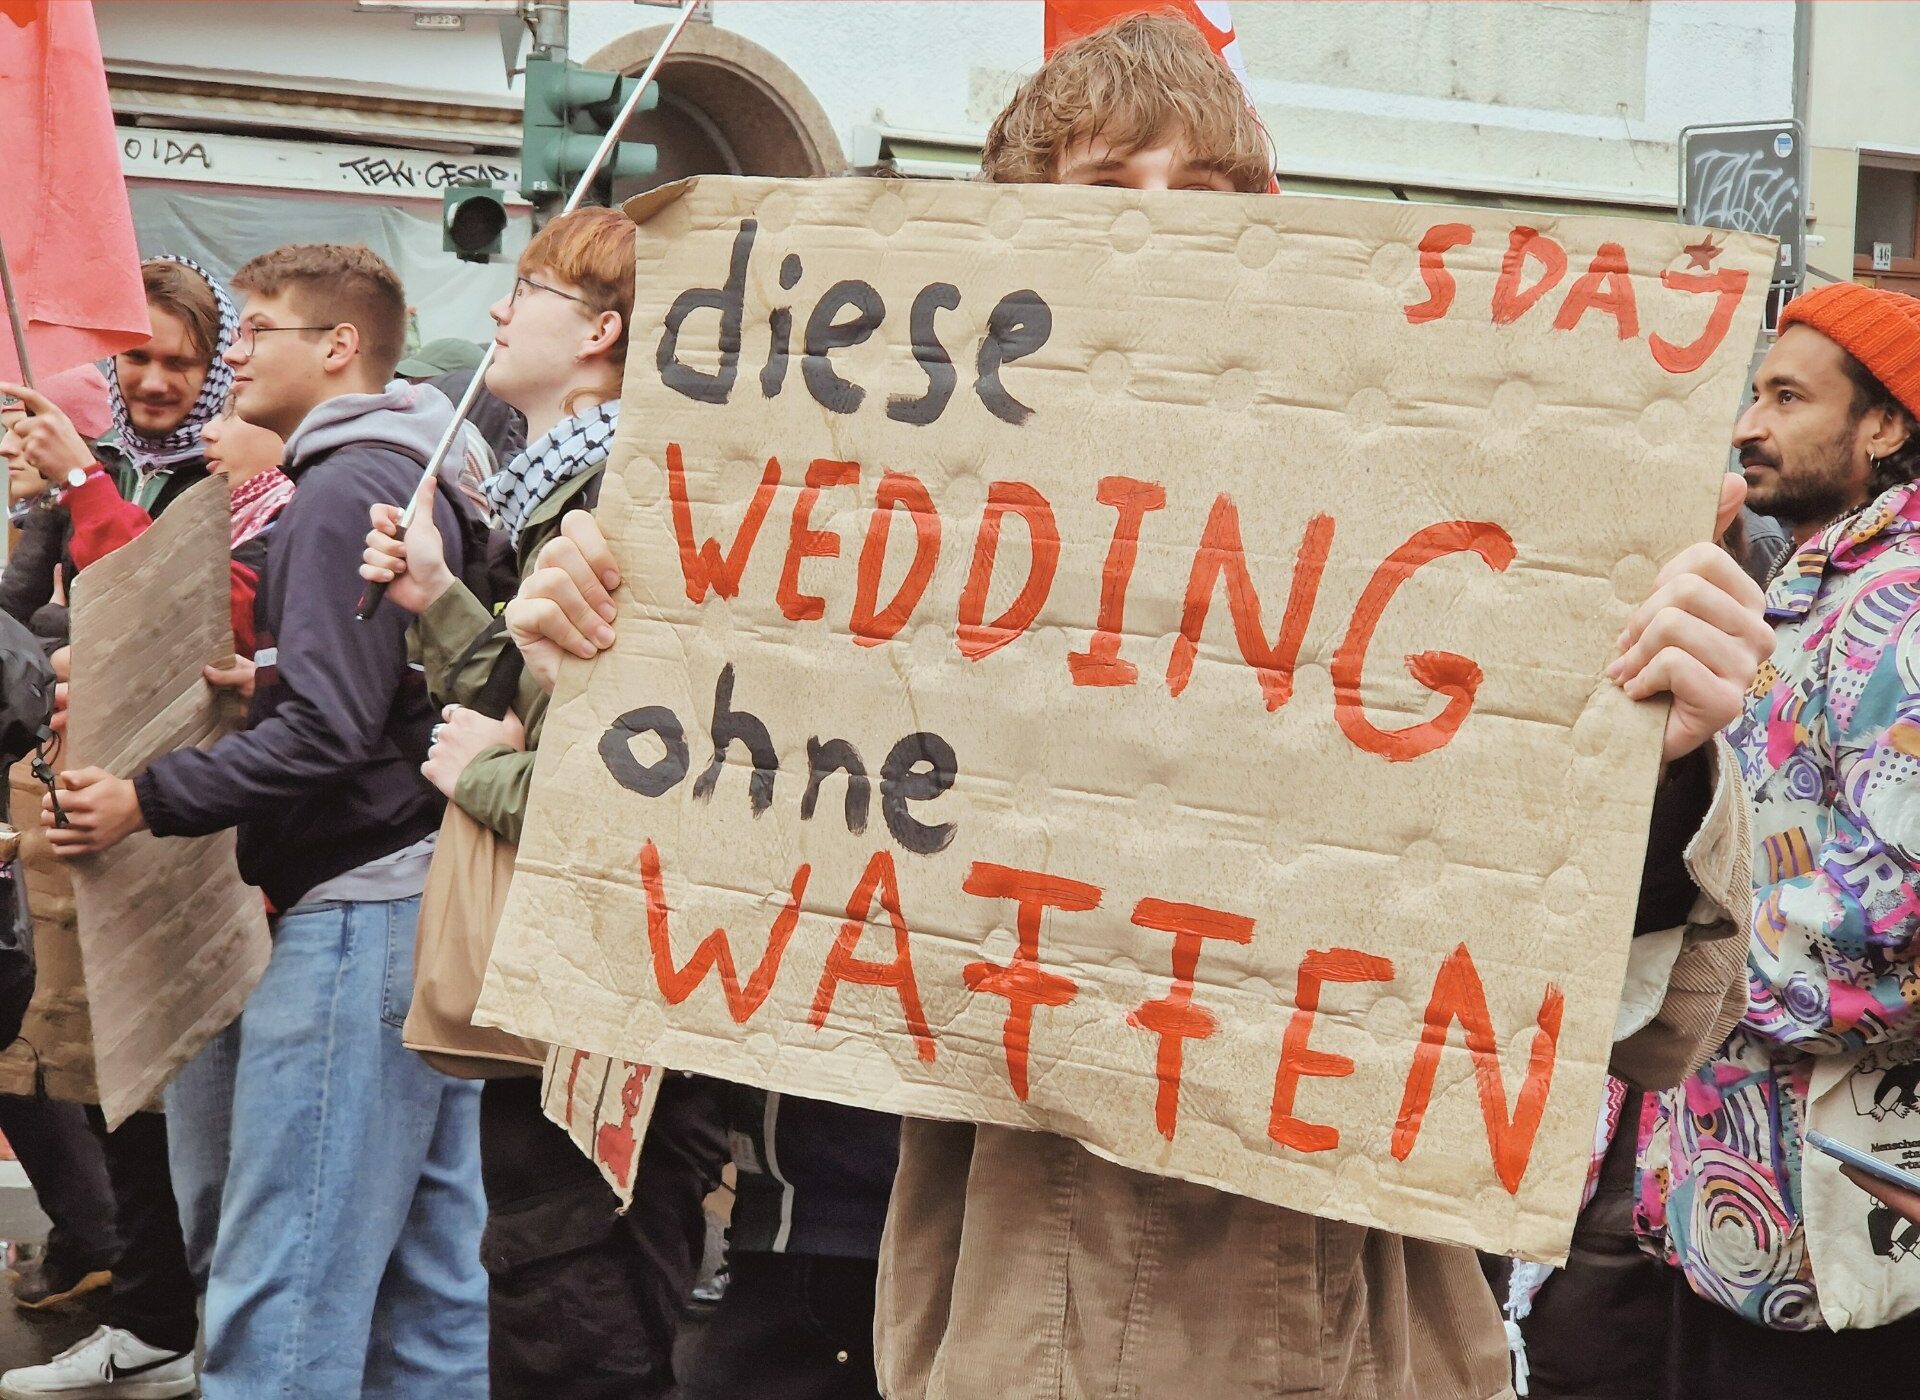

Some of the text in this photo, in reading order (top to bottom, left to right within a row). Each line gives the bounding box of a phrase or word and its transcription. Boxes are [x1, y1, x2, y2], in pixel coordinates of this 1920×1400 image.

[656, 218, 1053, 427] diese
[1403, 222, 1749, 373] SDAJ
[666, 442, 1517, 762] WEDDING
[599, 662, 959, 855] ohne
[641, 838, 1565, 1196] WATTEN
